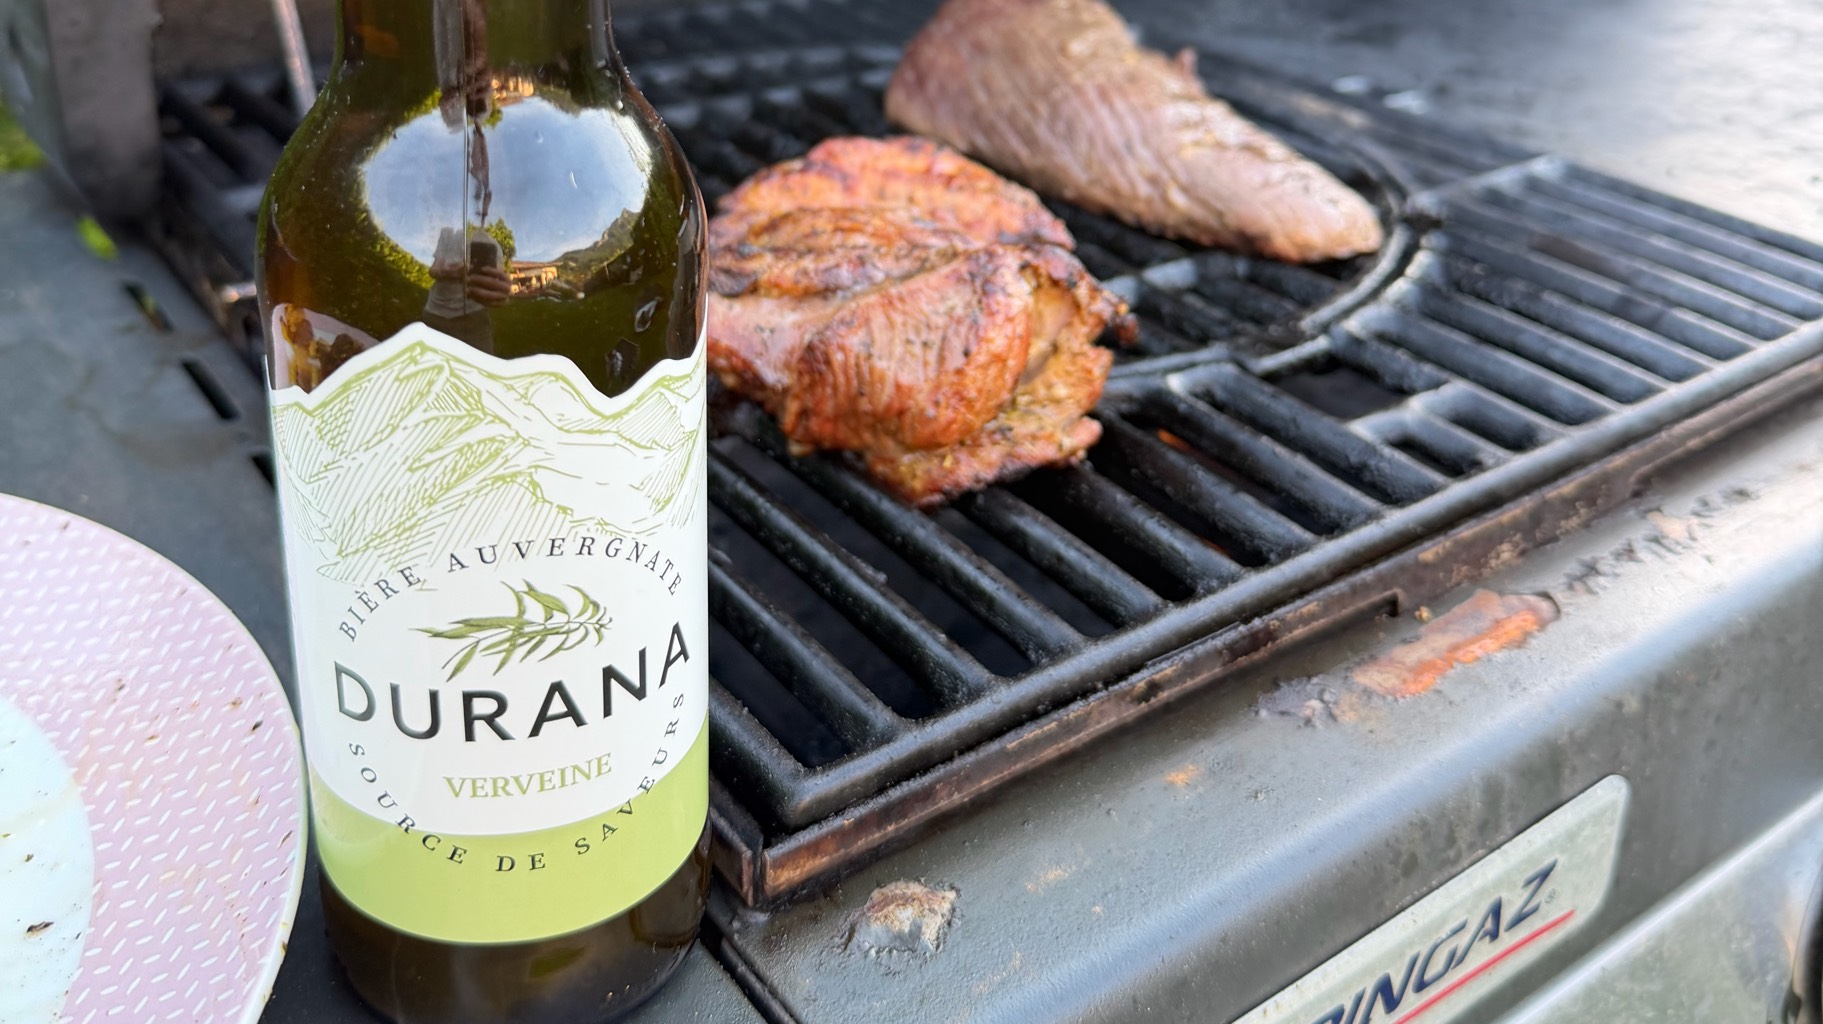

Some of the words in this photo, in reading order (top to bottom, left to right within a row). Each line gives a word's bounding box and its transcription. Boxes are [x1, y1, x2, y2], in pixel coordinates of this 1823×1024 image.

[339, 566, 421, 642] BIÈRE
[447, 536, 683, 597] AUVERGNATE
[334, 621, 690, 743] DURANA
[349, 742, 467, 864] SOURCE
[495, 853, 546, 872] DE
[574, 692, 684, 856] SAVEURS
[443, 753, 612, 799] VERVEINE
